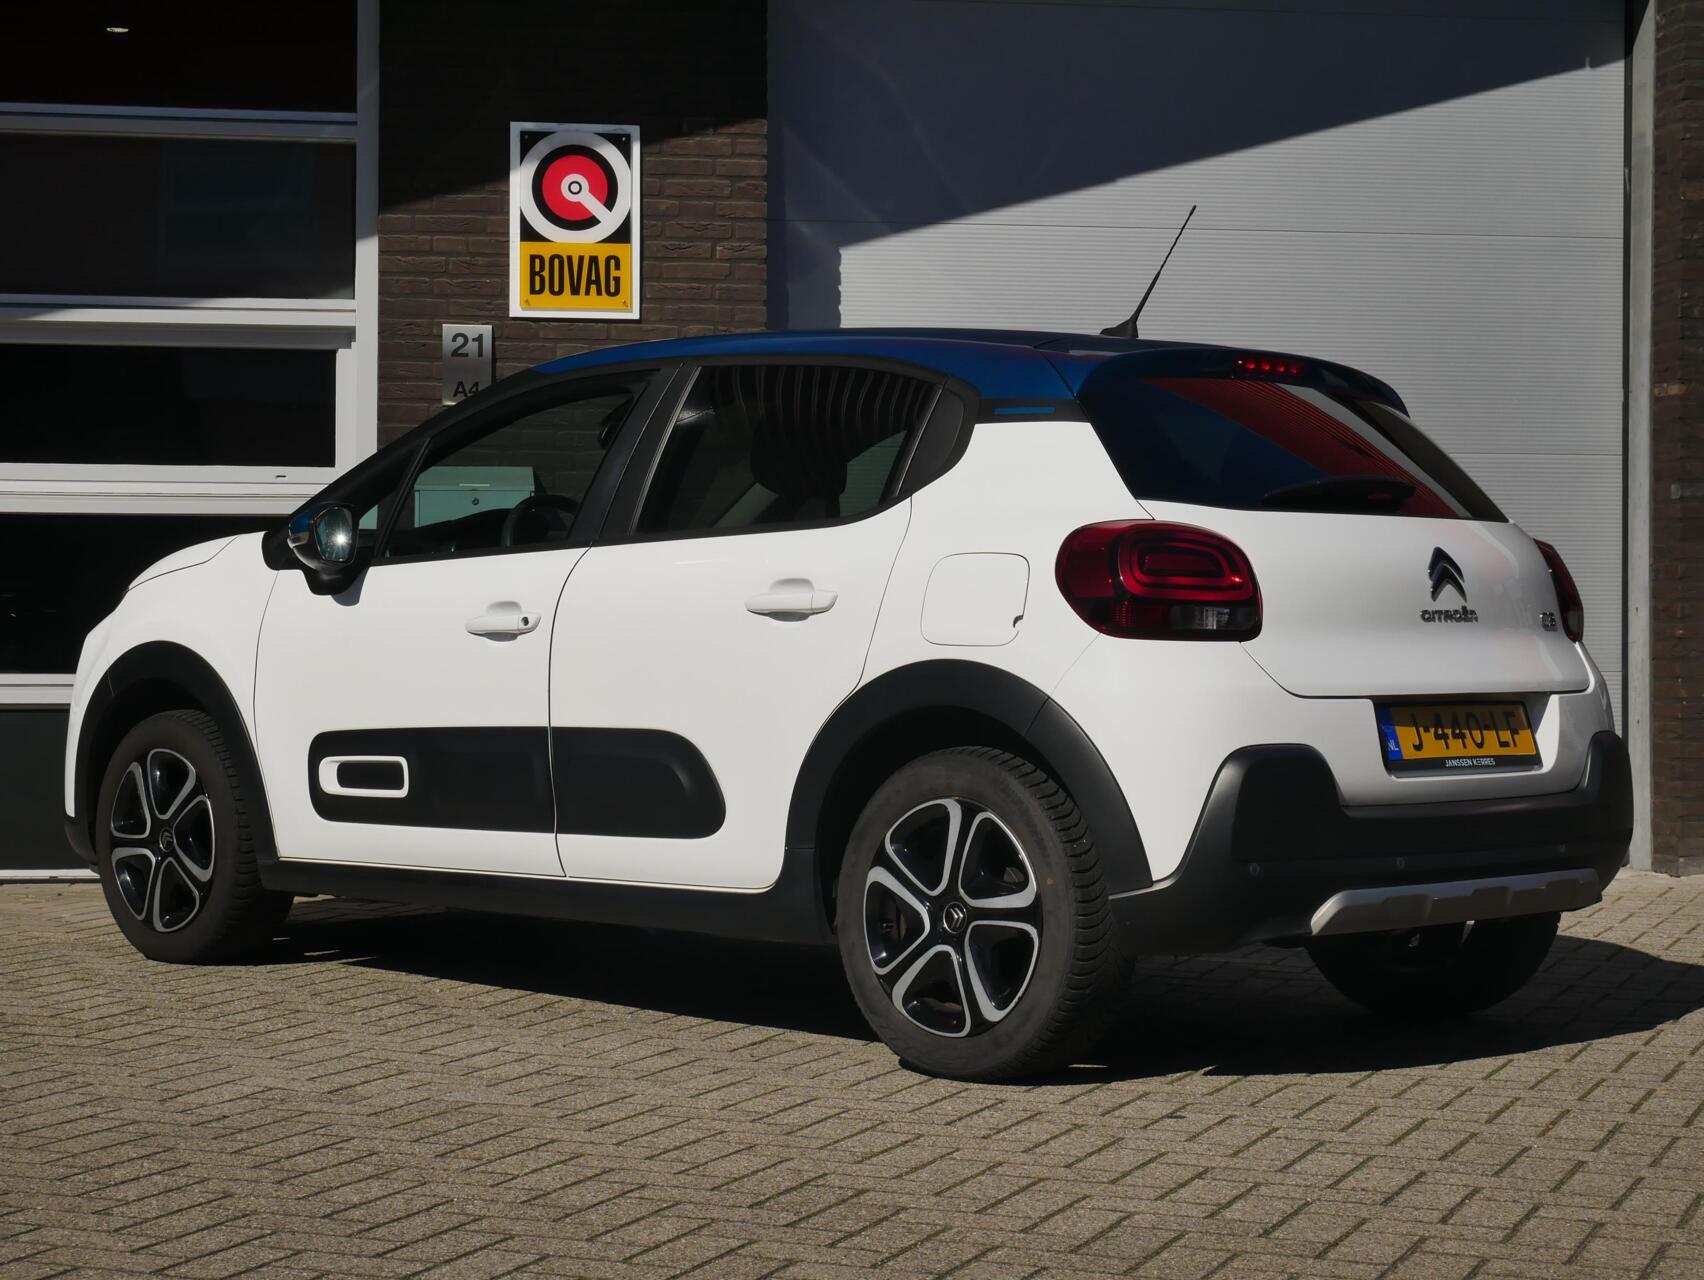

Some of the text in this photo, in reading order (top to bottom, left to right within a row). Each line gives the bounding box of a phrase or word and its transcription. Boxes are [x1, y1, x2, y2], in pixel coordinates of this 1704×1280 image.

[529, 254, 621, 297] BOVAG
[451, 333, 484, 358] 21
[1410, 711, 1520, 752] J-440-LF
[1387, 739, 1399, 751] NL
[1445, 759, 1473, 767] JANSSEN
